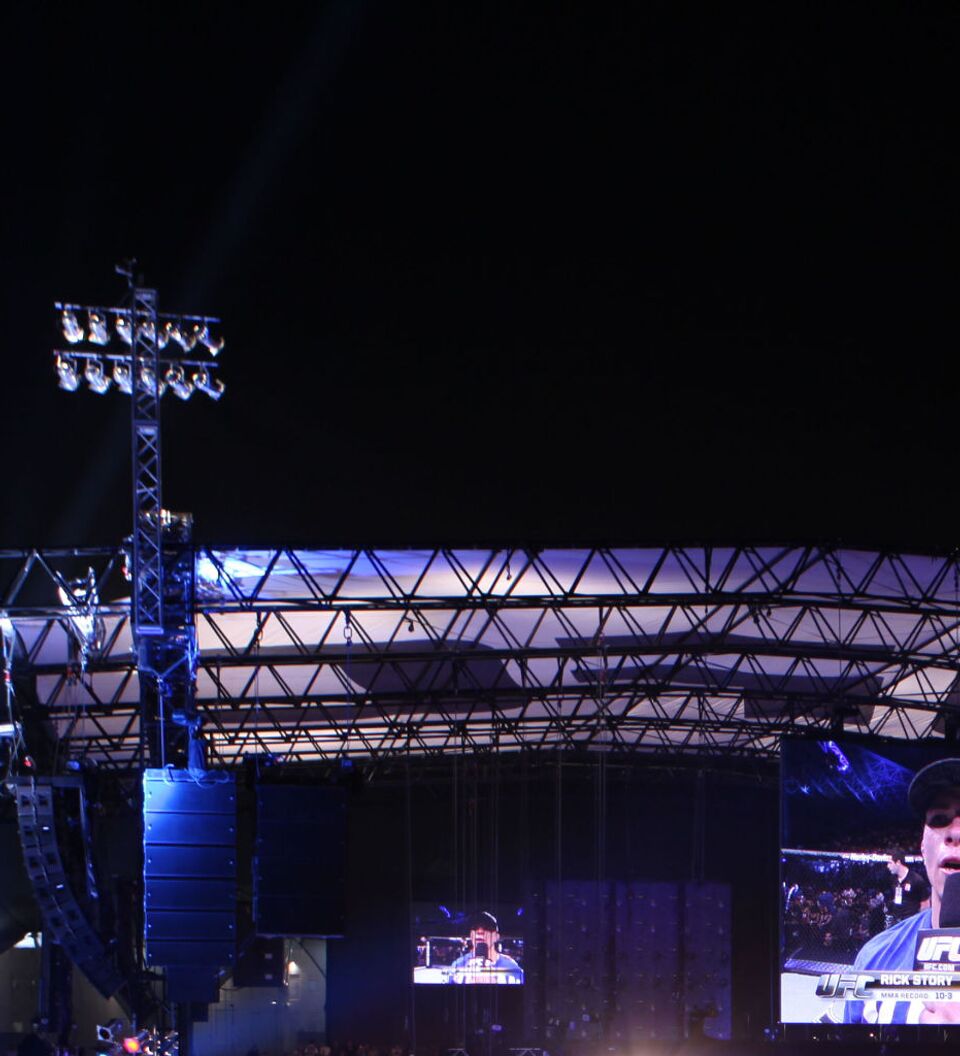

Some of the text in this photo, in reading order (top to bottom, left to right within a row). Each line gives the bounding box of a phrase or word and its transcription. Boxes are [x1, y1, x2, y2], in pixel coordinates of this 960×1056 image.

[816, 974, 875, 998] UFC
[880, 974, 953, 986] RICK STORY
